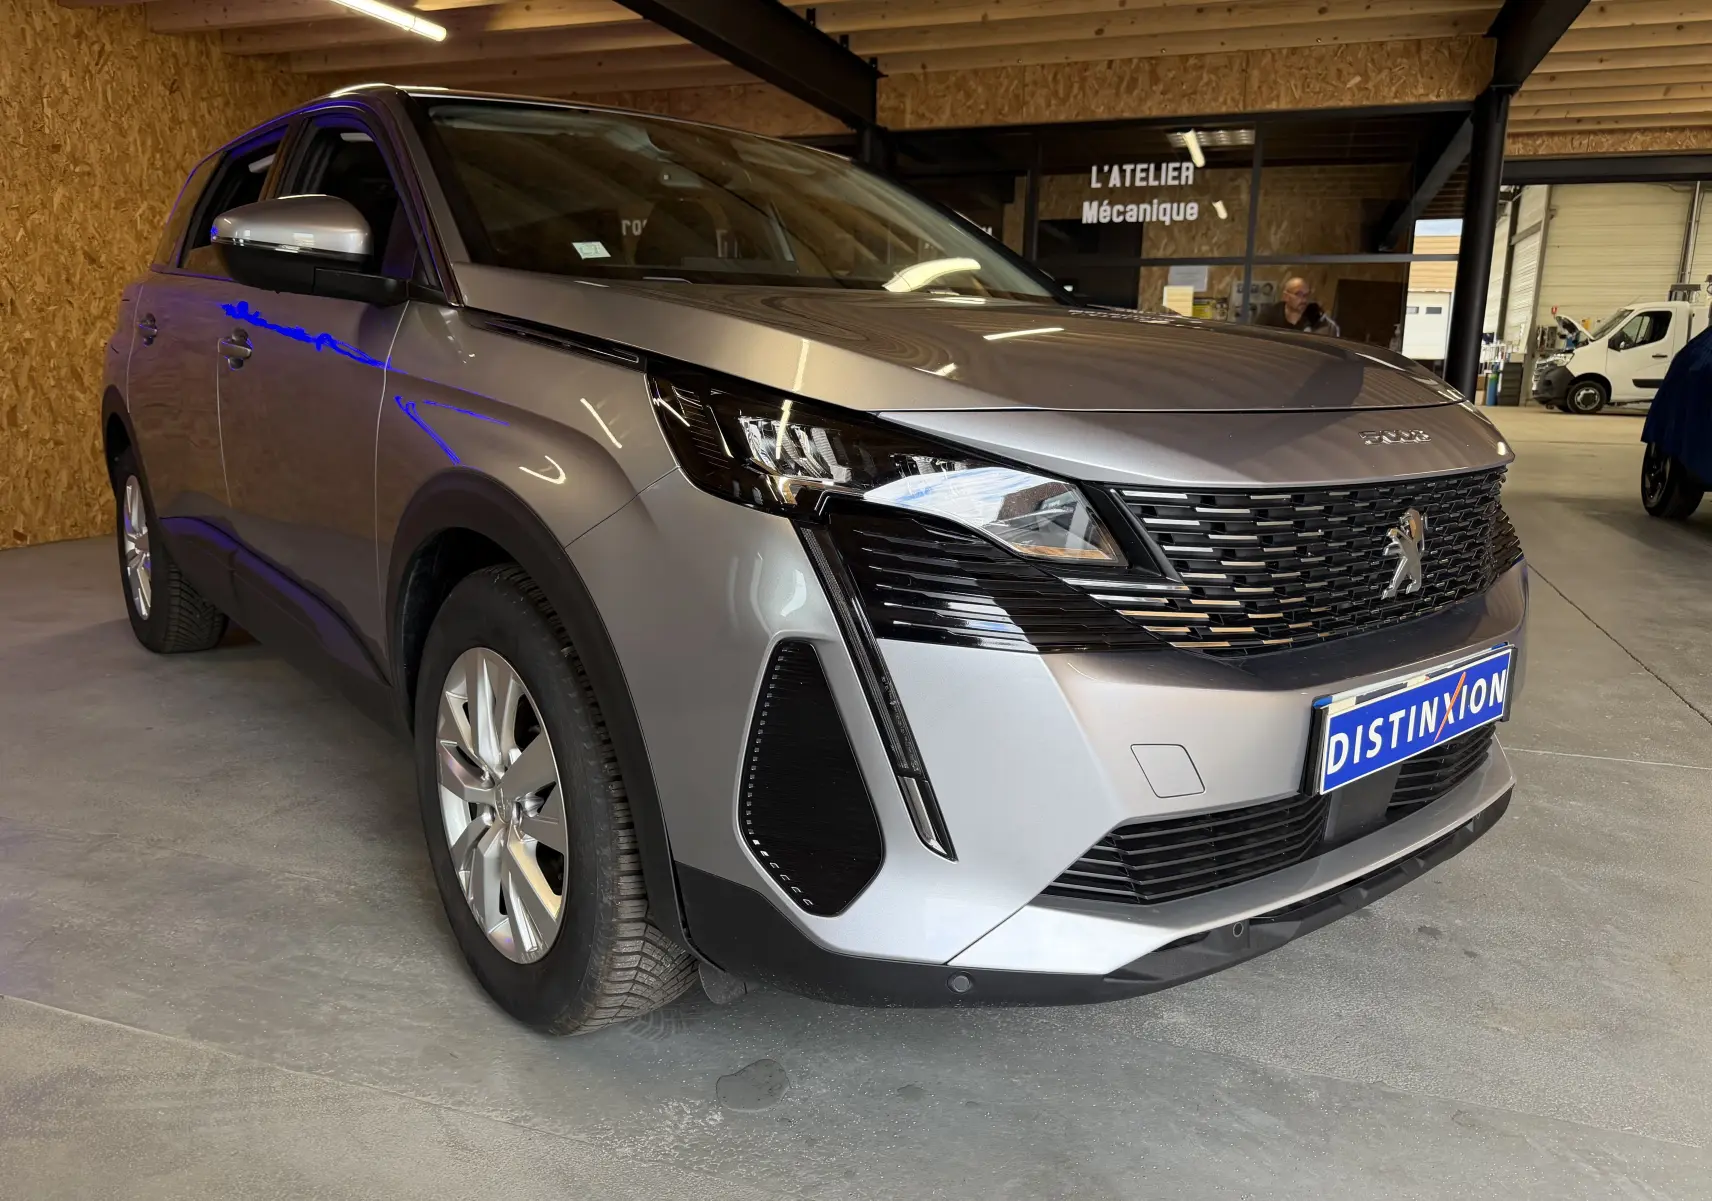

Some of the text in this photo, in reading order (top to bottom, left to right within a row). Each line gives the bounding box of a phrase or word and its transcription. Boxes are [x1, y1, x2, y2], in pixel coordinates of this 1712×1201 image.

[1090, 161, 1194, 189] L'ATELIER
[1081, 198, 1199, 226] Mécanique
[1326, 668, 1508, 776] DISTINXION
